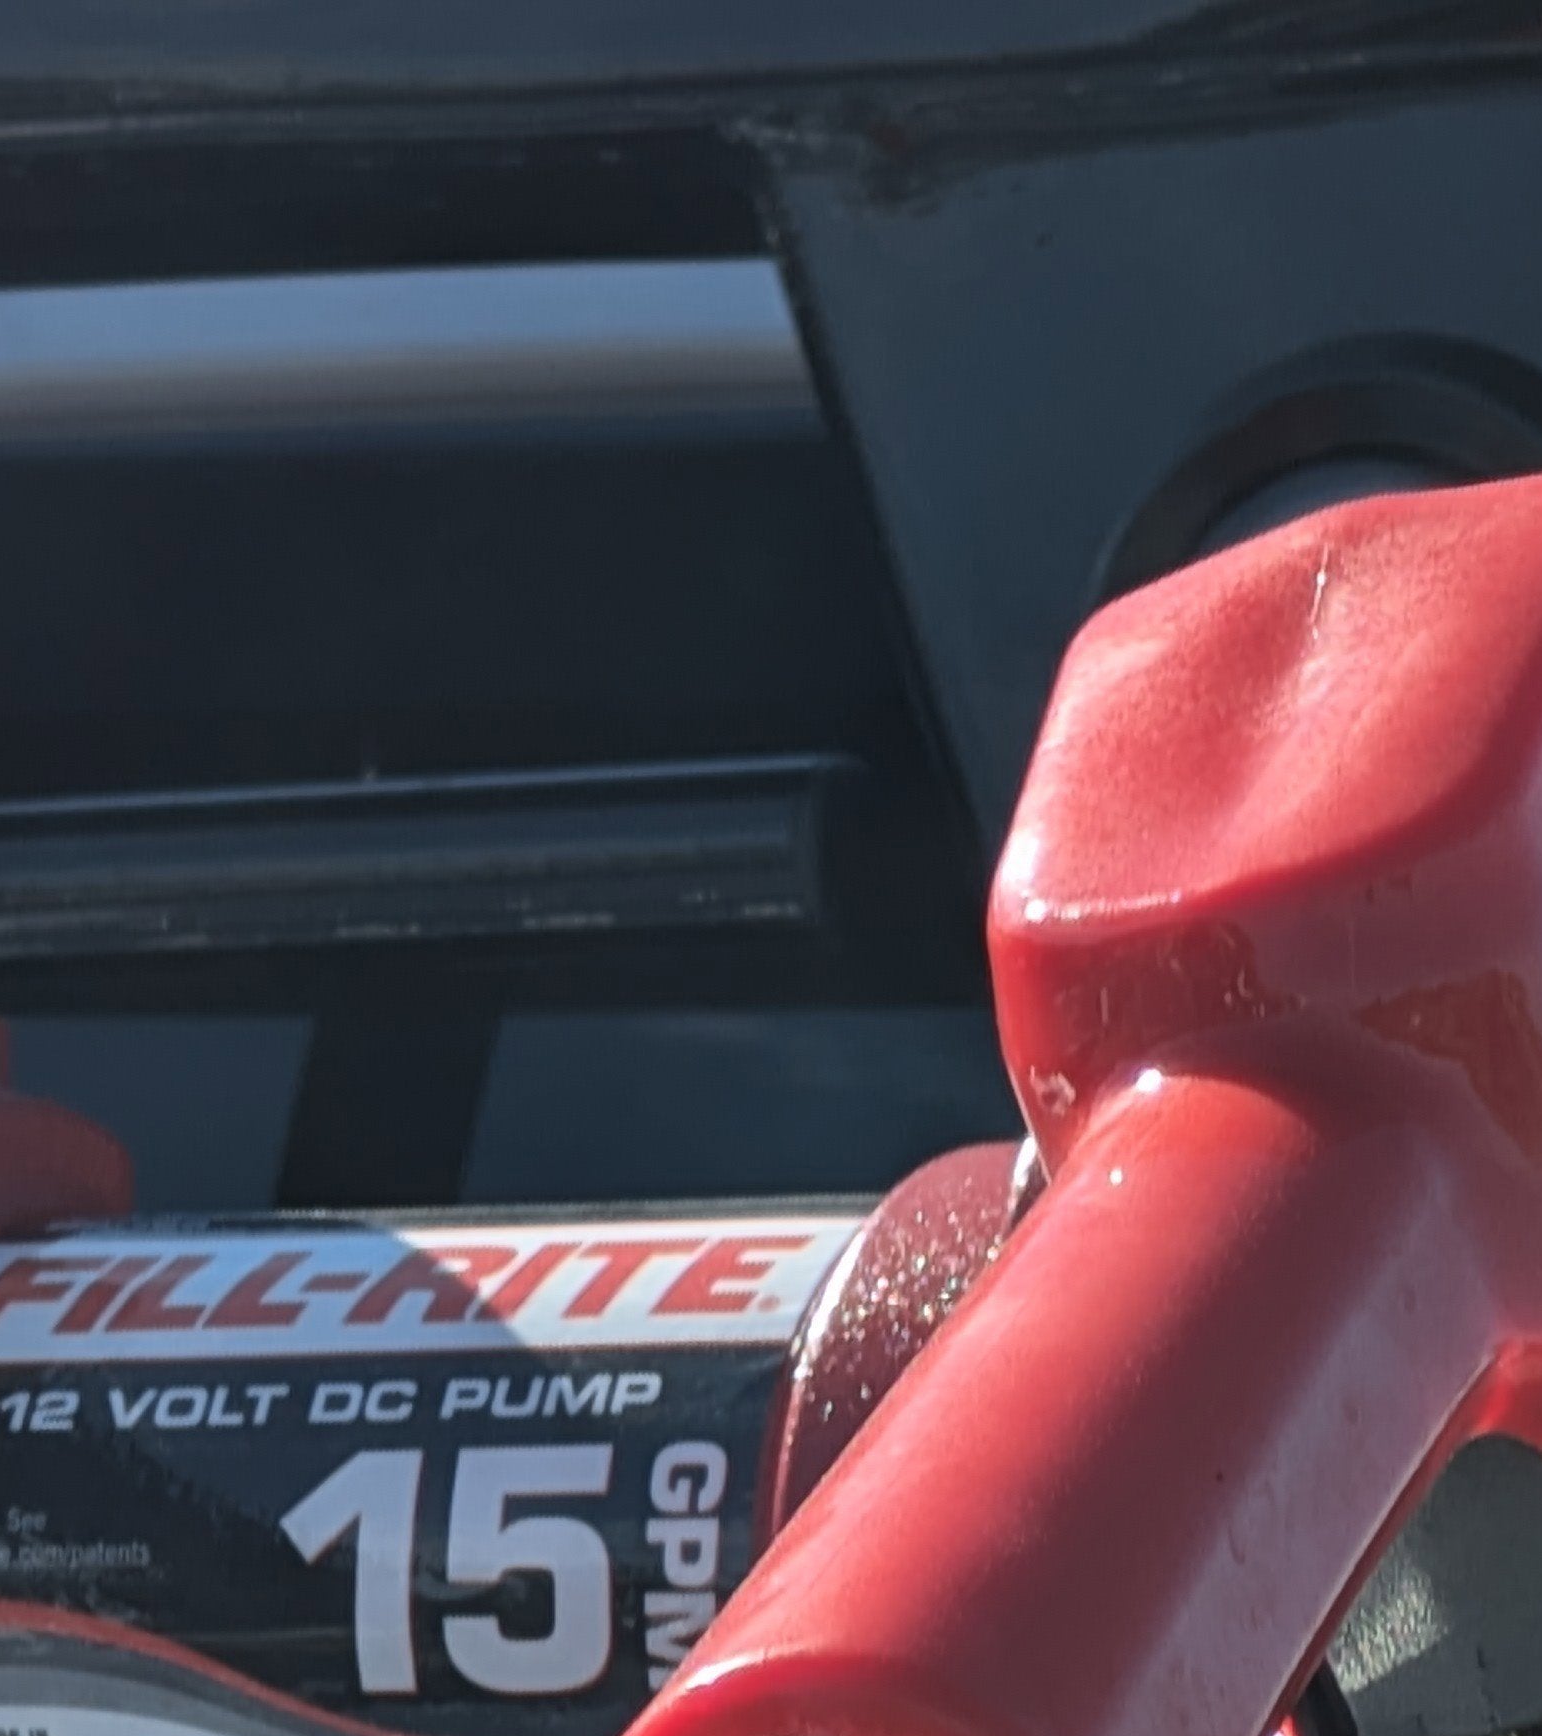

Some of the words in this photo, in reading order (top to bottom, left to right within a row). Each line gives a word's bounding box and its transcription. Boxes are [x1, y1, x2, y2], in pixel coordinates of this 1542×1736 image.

[107, 1383, 291, 1431] VOLT
[307, 1377, 419, 1425] DC
[437, 1372, 664, 1422] PUMP
[279, 1441, 615, 1696] 15
